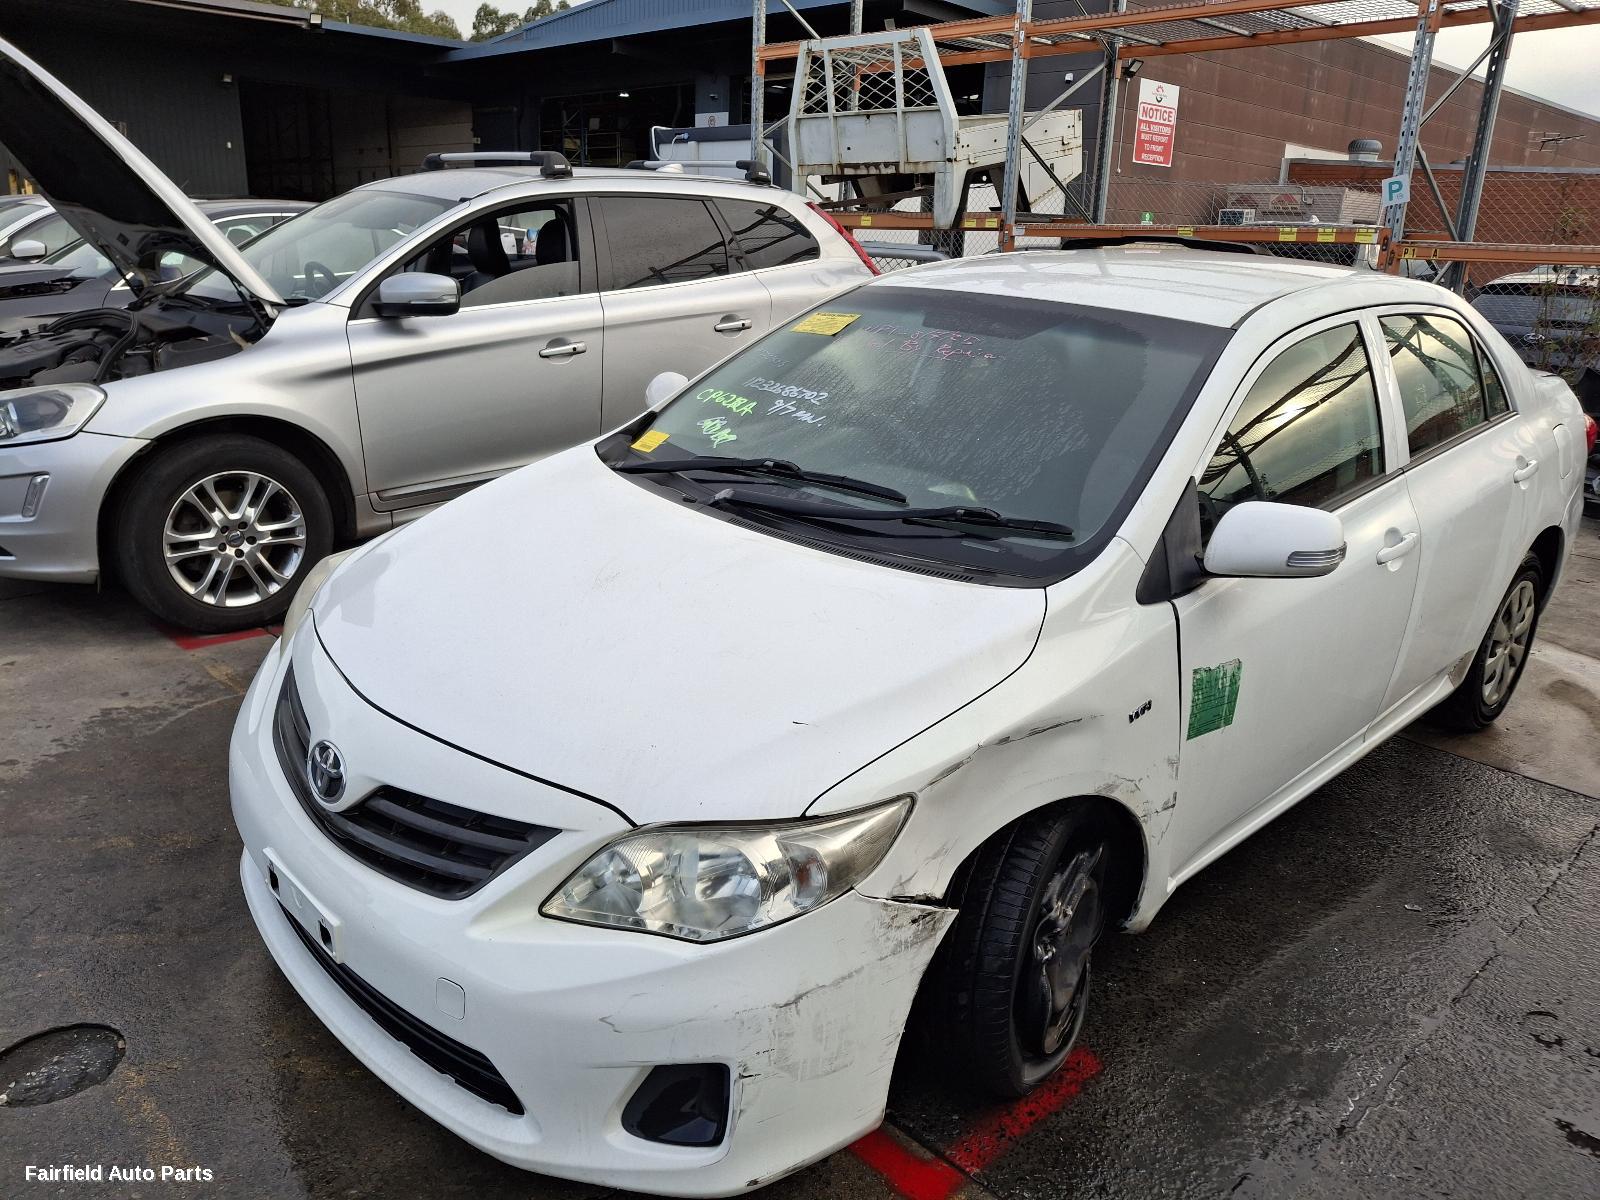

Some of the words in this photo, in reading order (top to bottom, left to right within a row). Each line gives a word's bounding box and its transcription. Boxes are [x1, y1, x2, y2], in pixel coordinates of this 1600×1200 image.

[1141, 105, 1173, 122] NOTICE
[1140, 122, 1150, 131] ALL
[1150, 124, 1172, 134] VISITORS
[1141, 153, 1164, 162] RECEPTION
[1388, 181, 1403, 201] P
[1432, 248, 1438, 258] A
